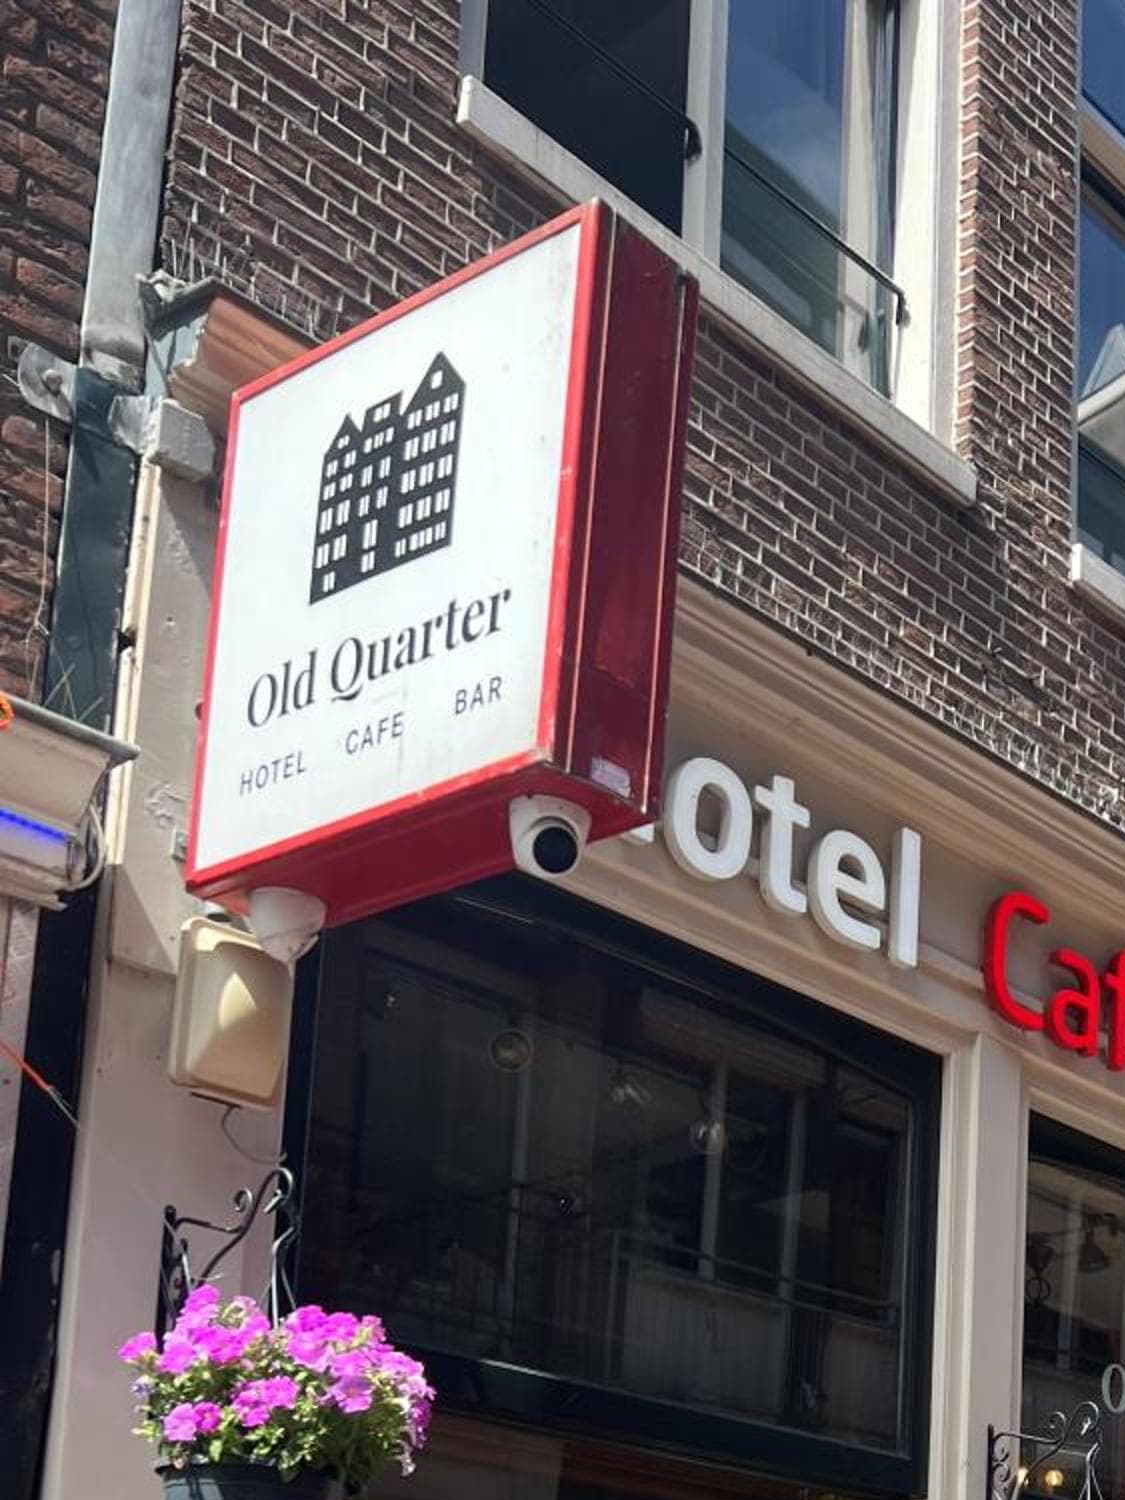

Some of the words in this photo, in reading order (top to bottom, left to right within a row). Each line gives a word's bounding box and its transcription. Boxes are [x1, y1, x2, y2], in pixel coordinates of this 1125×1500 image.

[246, 648, 319, 728] Old
[329, 587, 512, 702] Quarter
[239, 750, 307, 796] HOTEL
[344, 711, 406, 756] CAFE
[453, 674, 502, 715] BAR
[629, 757, 922, 968] otel
